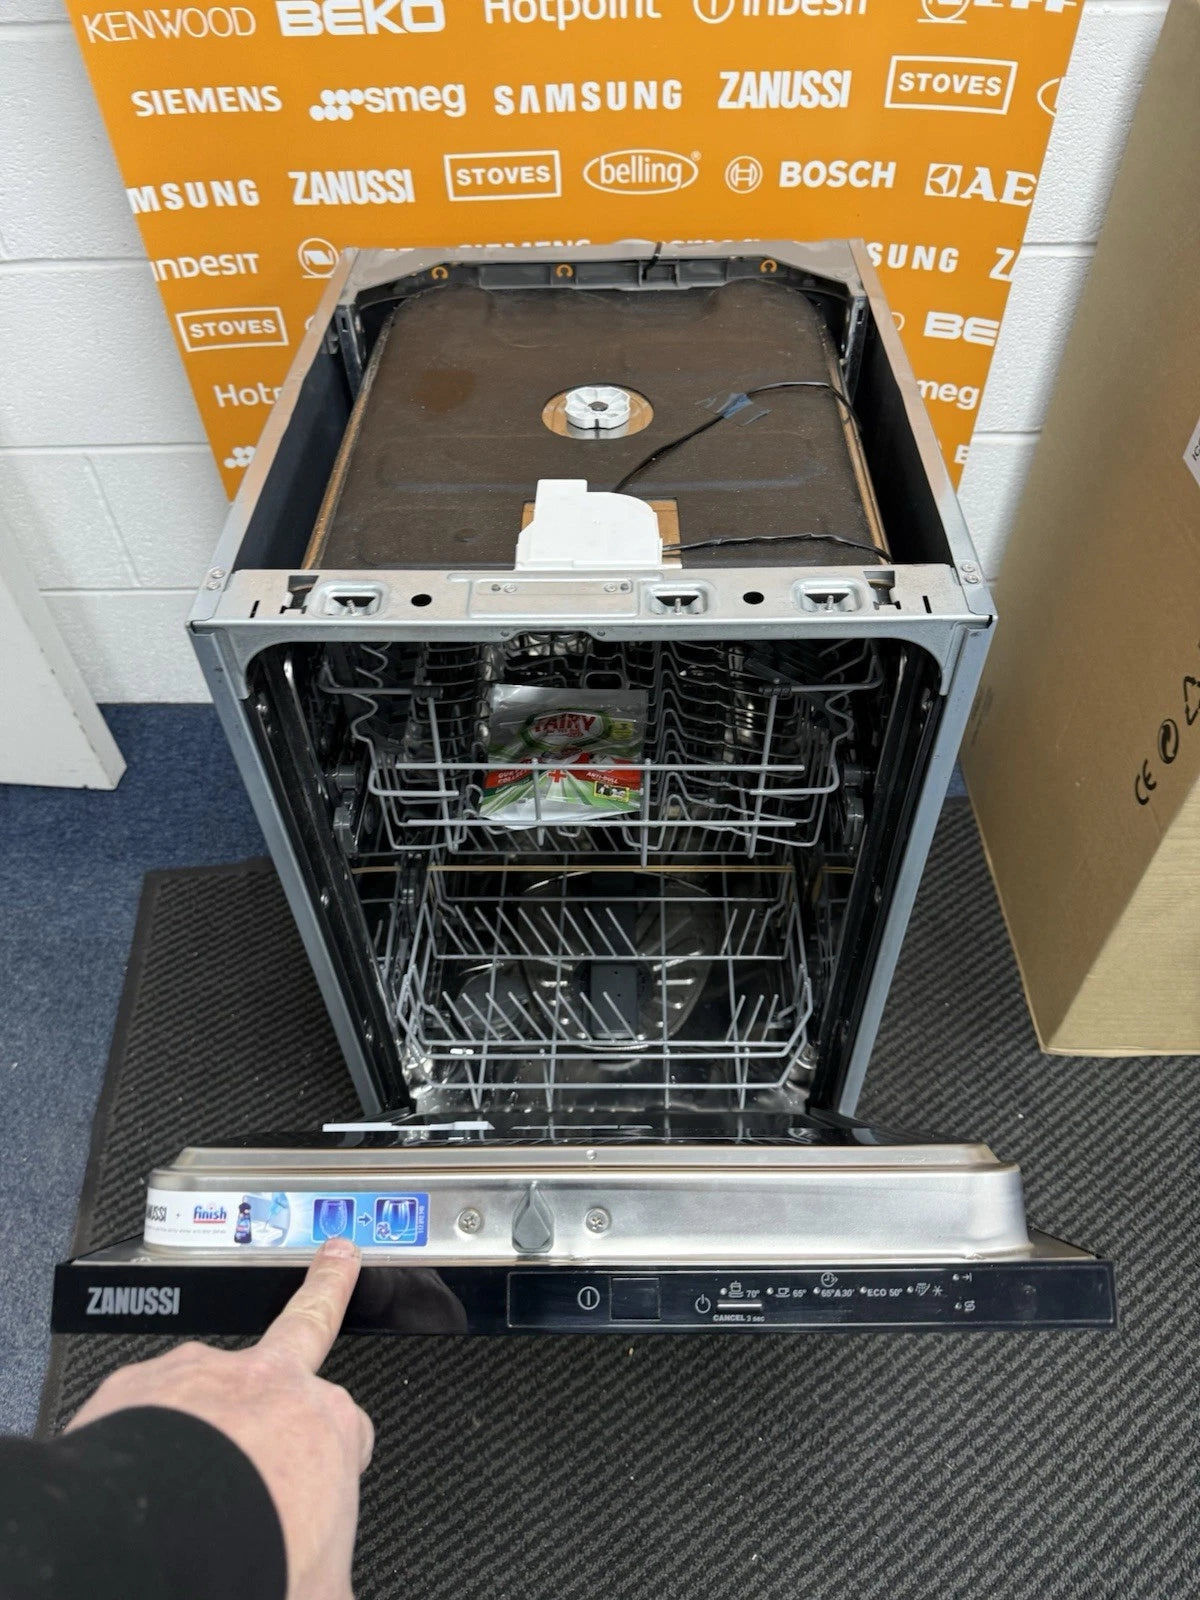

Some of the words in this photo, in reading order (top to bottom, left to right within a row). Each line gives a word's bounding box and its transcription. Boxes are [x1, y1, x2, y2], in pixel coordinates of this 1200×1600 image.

[82, 7, 256, 43] KENWOOD
[275, 0, 446, 36] BEKO
[363, 83, 467, 118] smeg
[494, 79, 683, 116] SAMSUNG
[718, 70, 852, 109] ZANUSSI
[898, 72, 1002, 97] STOVES
[131, 85, 283, 117] SIEMENS
[288, 169, 416, 206] ZANUSSI
[456, 165, 551, 186] STOVES
[600, 155, 683, 189] belling
[779, 160, 897, 188] BOSCH
[189, 318, 277, 338] STOVES
[193, 1206, 227, 1220] finish
[86, 1287, 180, 1315] ZANUSSI
[713, 1314, 745, 1322] CANCEL
